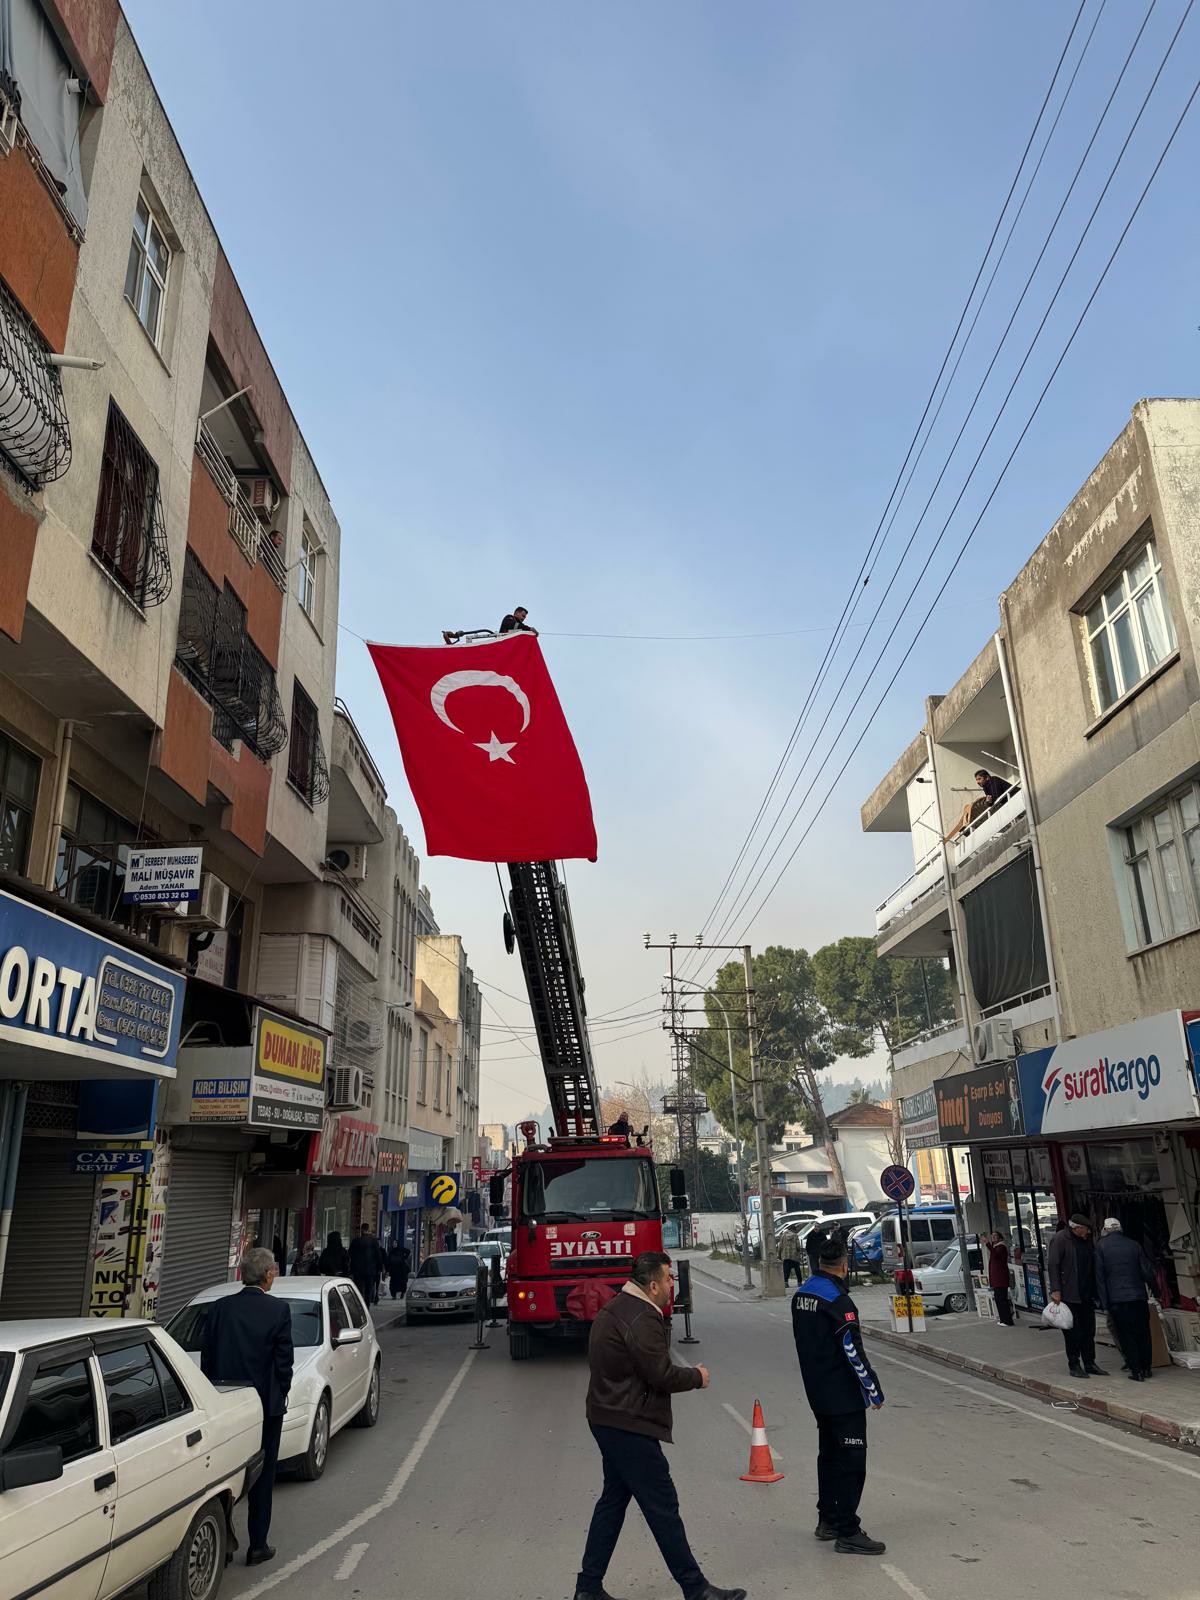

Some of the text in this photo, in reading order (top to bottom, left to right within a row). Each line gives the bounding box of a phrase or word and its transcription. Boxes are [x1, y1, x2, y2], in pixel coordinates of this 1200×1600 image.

[145, 856, 166, 867] SERBEST
[131, 868, 195, 882] MALİ MÜŞAVİR
[0, 946, 96, 1041] ORTA
[263, 1031, 321, 1075] DUMAN BÜFE
[939, 1084, 970, 1135] imaj
[970, 1086, 988, 1102] Eşarp
[994, 1079, 1006, 1099] Şal
[76, 1152, 143, 1164] CAFE
[76, 1164, 118, 1172] KEYİF
[844, 1438, 864, 1446] ZABITA
